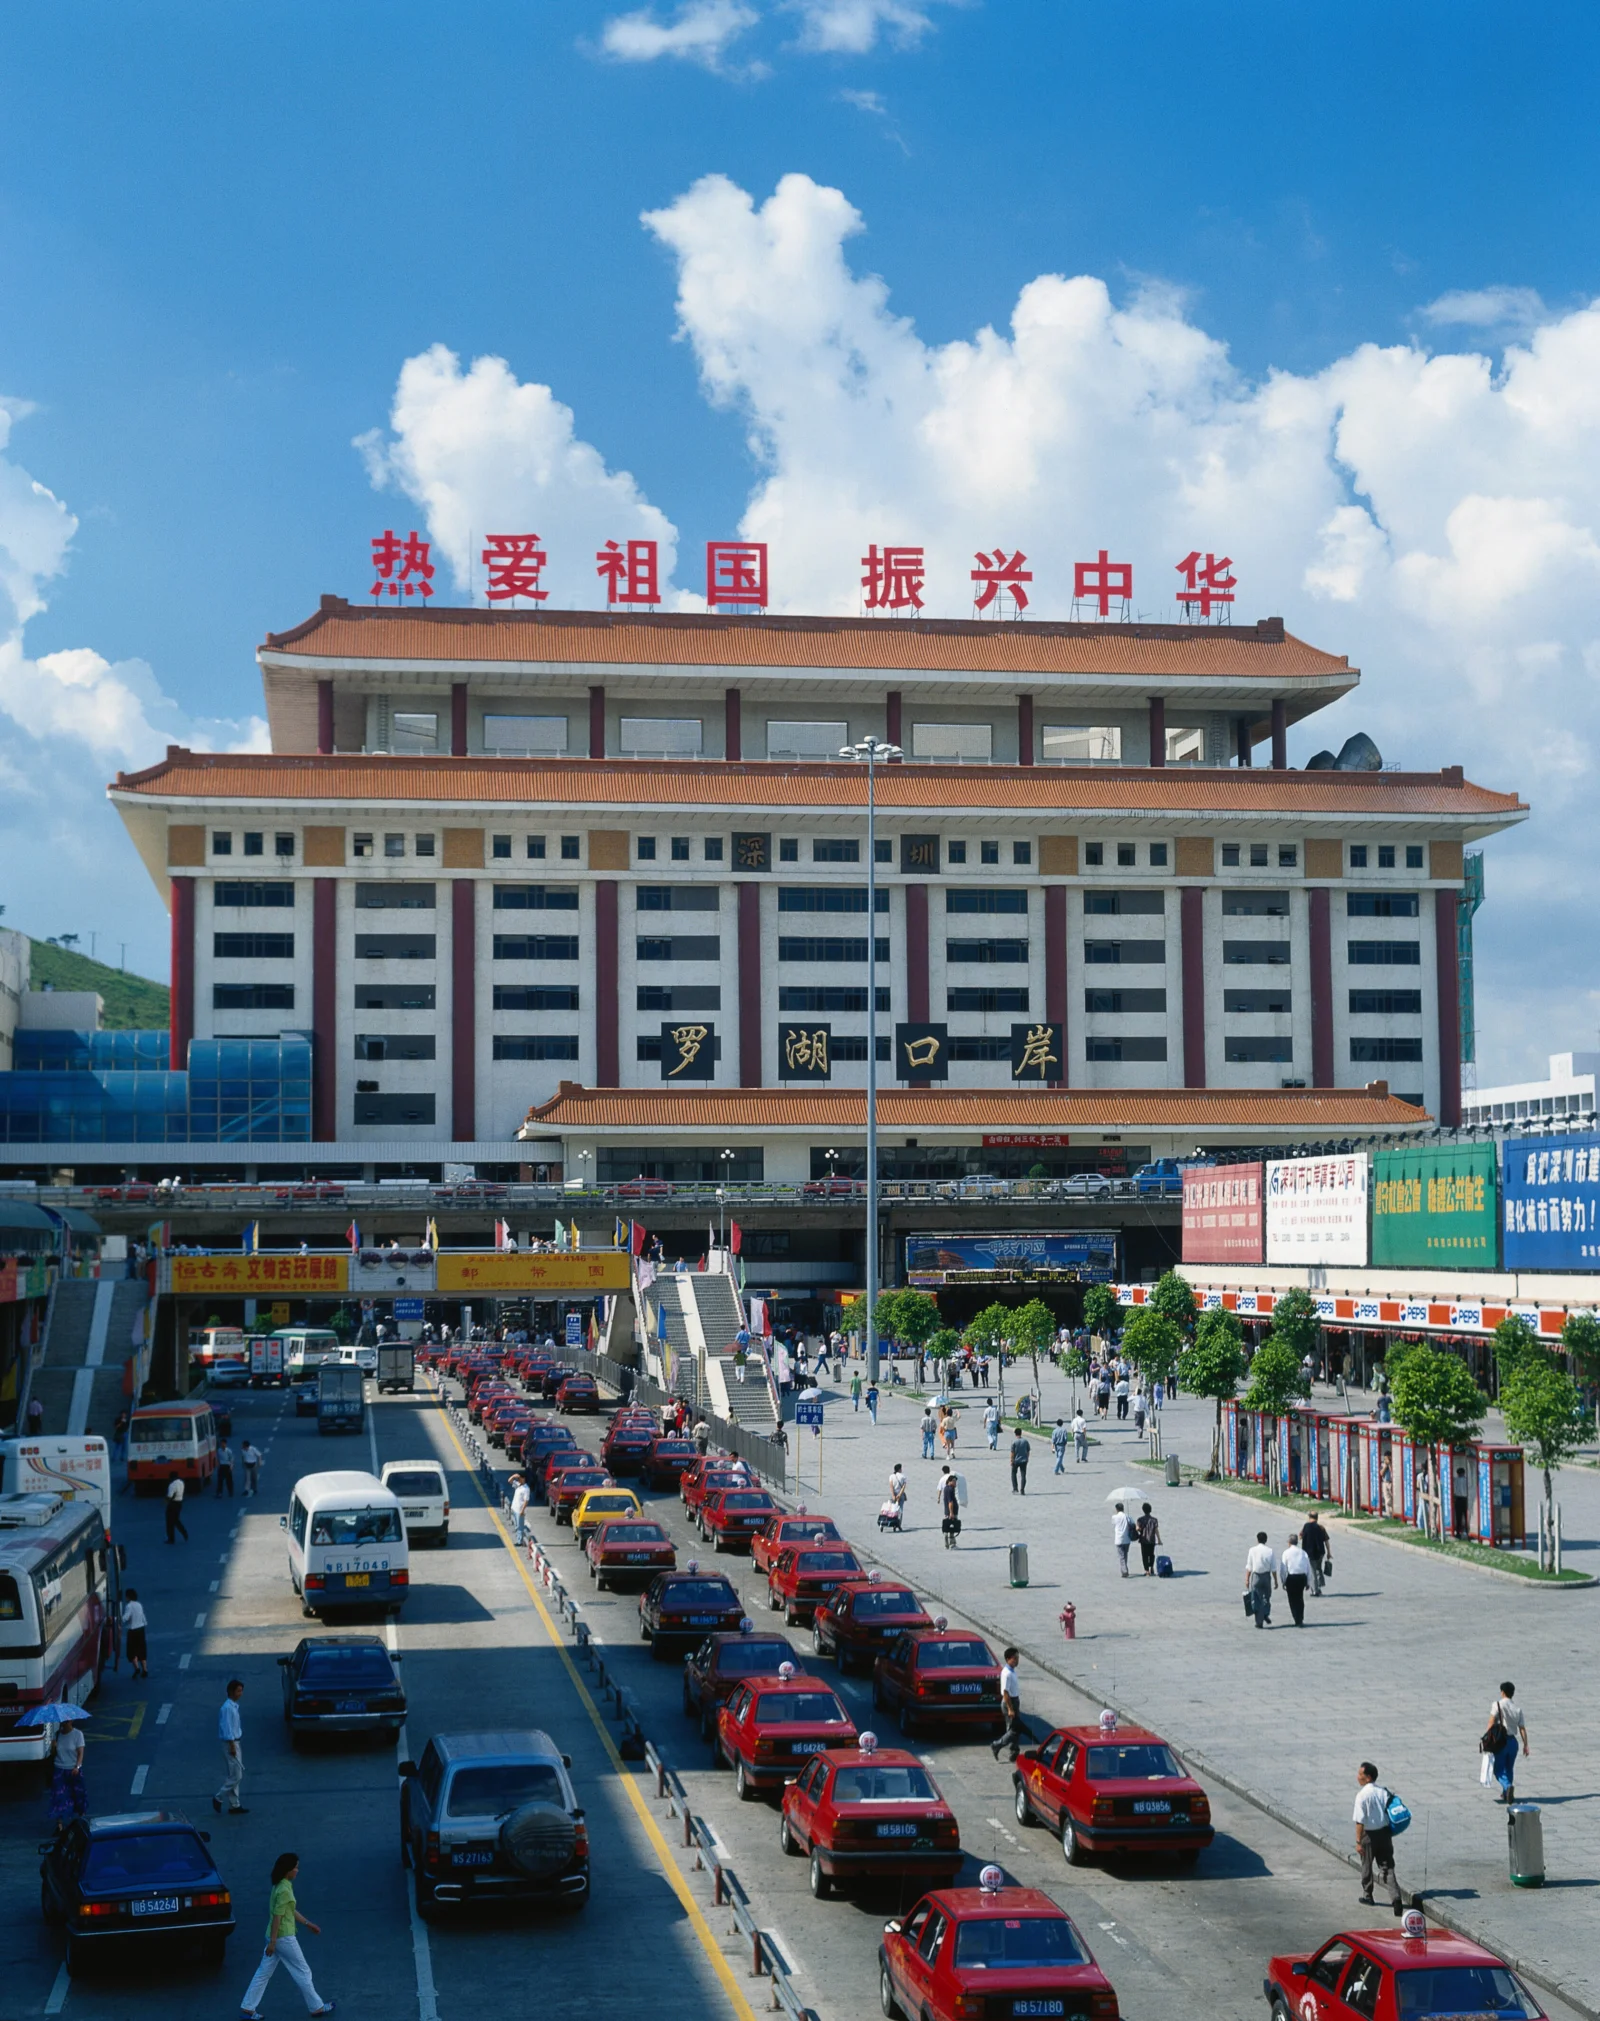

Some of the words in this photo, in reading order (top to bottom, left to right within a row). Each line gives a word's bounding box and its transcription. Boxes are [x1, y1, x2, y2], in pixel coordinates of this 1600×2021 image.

[372, 530, 768, 608] 热爱祖国
[861, 544, 1236, 617] 振兴中华
[738, 837, 934, 868] 深圳
[667, 1024, 1058, 1079] 罗湖口岸
[1242, 1297, 1256, 1309] PEPSI
[1317, 1301, 1334, 1314] PEPSI
[1360, 1303, 1378, 1317] PEPSI
[1407, 1306, 1427, 1321] PEPSI
[1458, 1309, 1480, 1324] PEPSI
